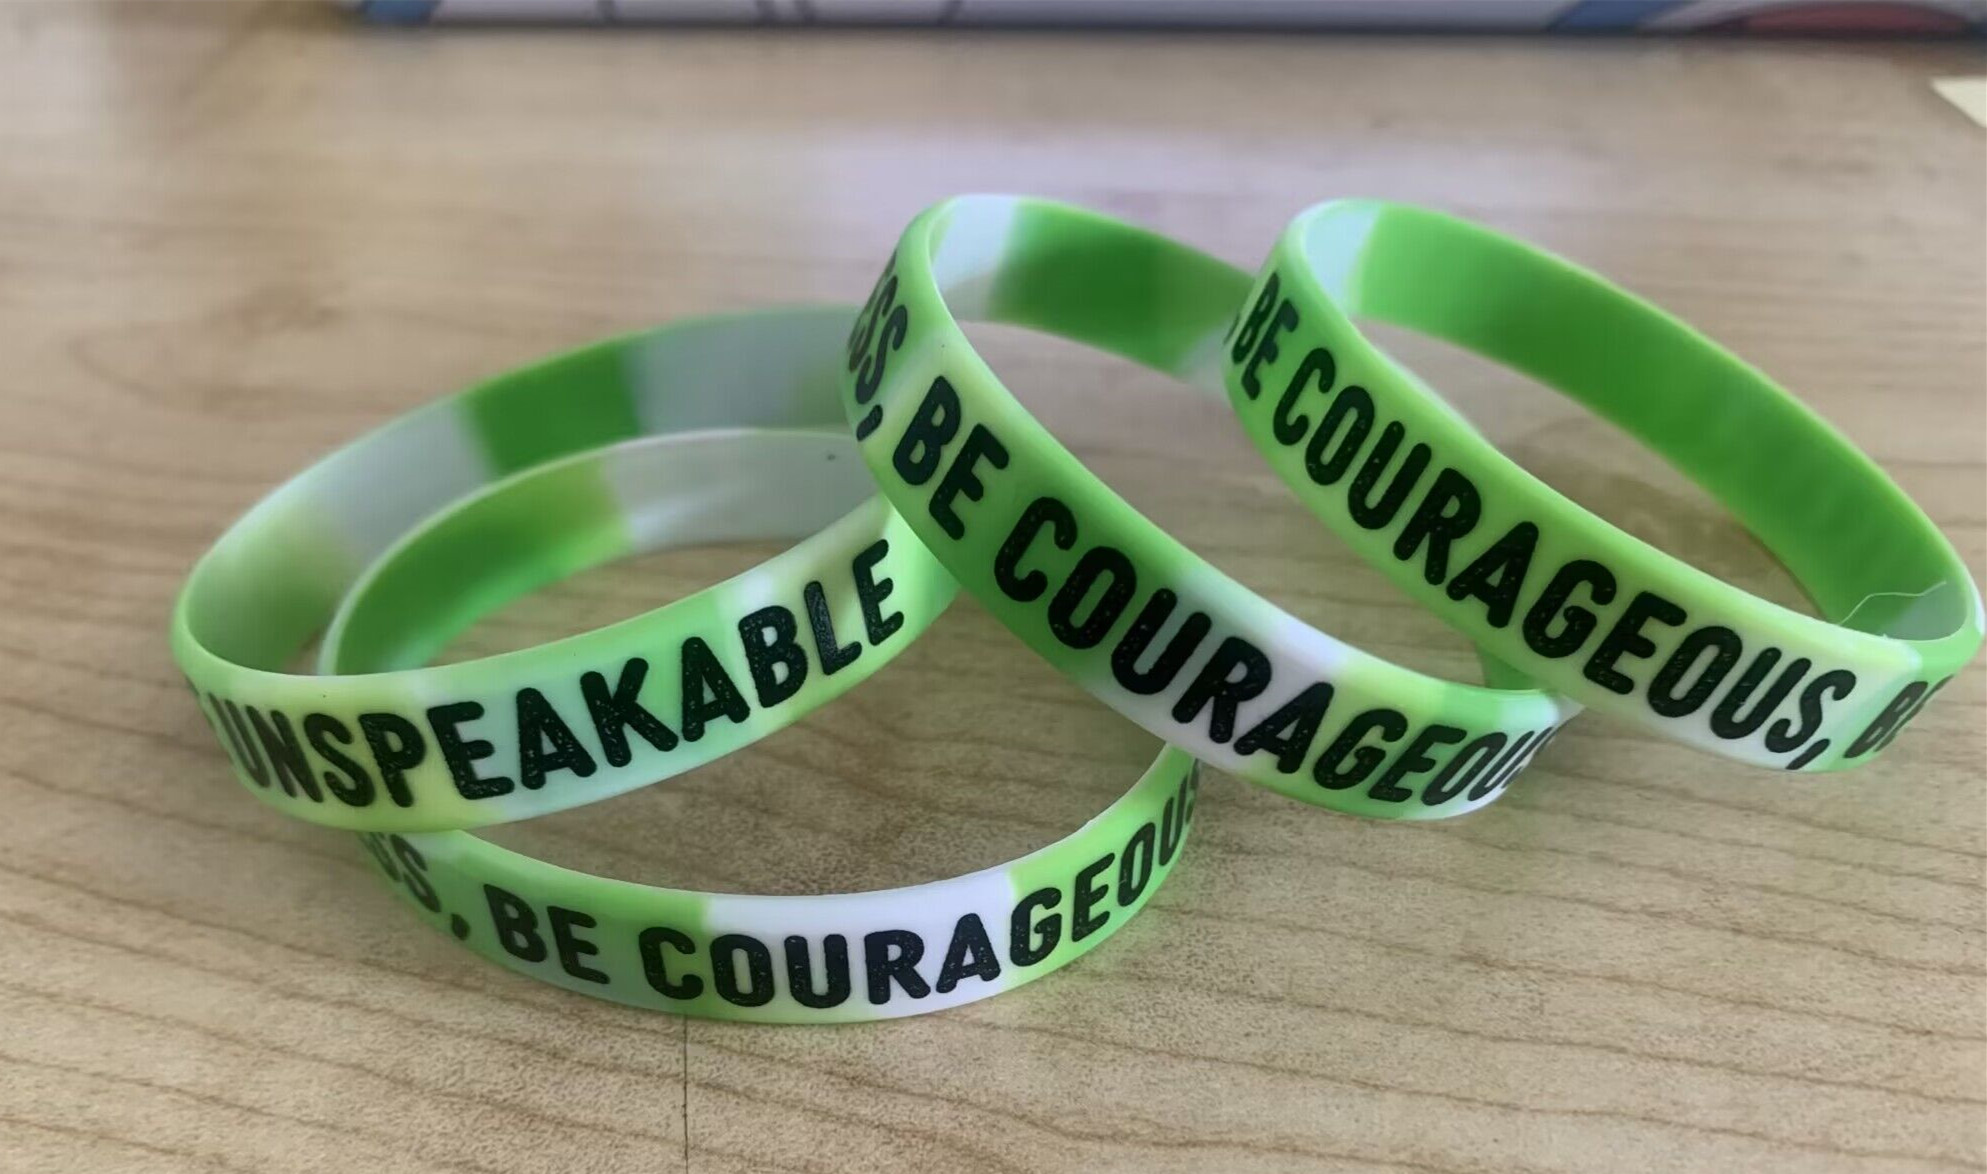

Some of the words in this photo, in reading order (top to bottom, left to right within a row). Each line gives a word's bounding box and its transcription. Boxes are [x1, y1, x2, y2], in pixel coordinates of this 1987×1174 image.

[207, 538, 905, 809] UNSPEAKABLE
[892, 375, 1010, 541] BE
[993, 495, 1556, 808] COURAGEOU
[1231, 271, 1299, 401] BE
[1272, 346, 1858, 771] COURAGEOUS,
[482, 883, 612, 986] BE
